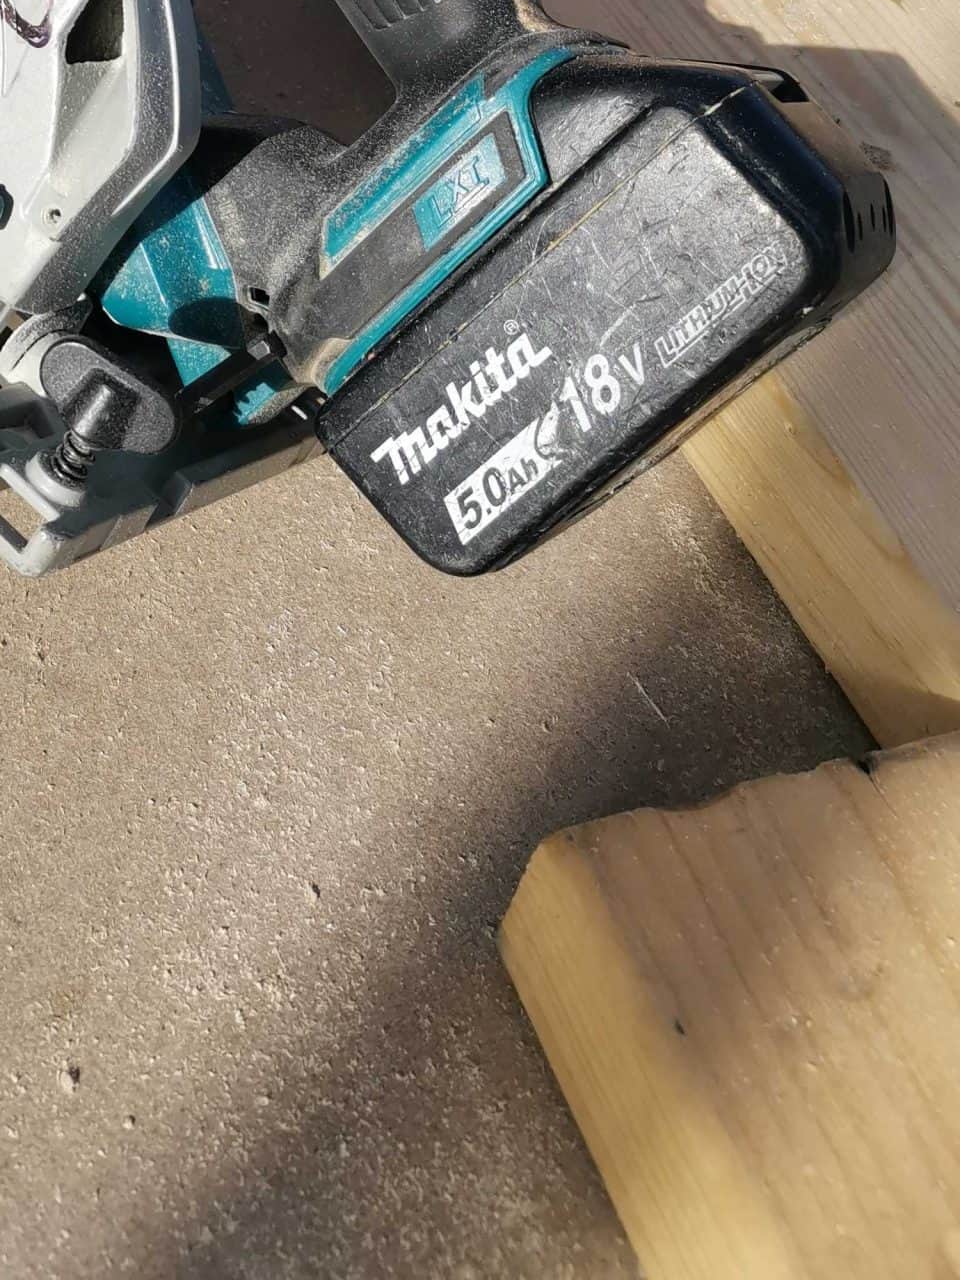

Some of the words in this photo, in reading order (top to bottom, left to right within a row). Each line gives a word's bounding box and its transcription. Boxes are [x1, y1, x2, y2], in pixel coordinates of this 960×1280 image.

[426, 154, 491, 229] LXT
[369, 332, 553, 486] Makita
[456, 456, 540, 531] 5.0Ah
